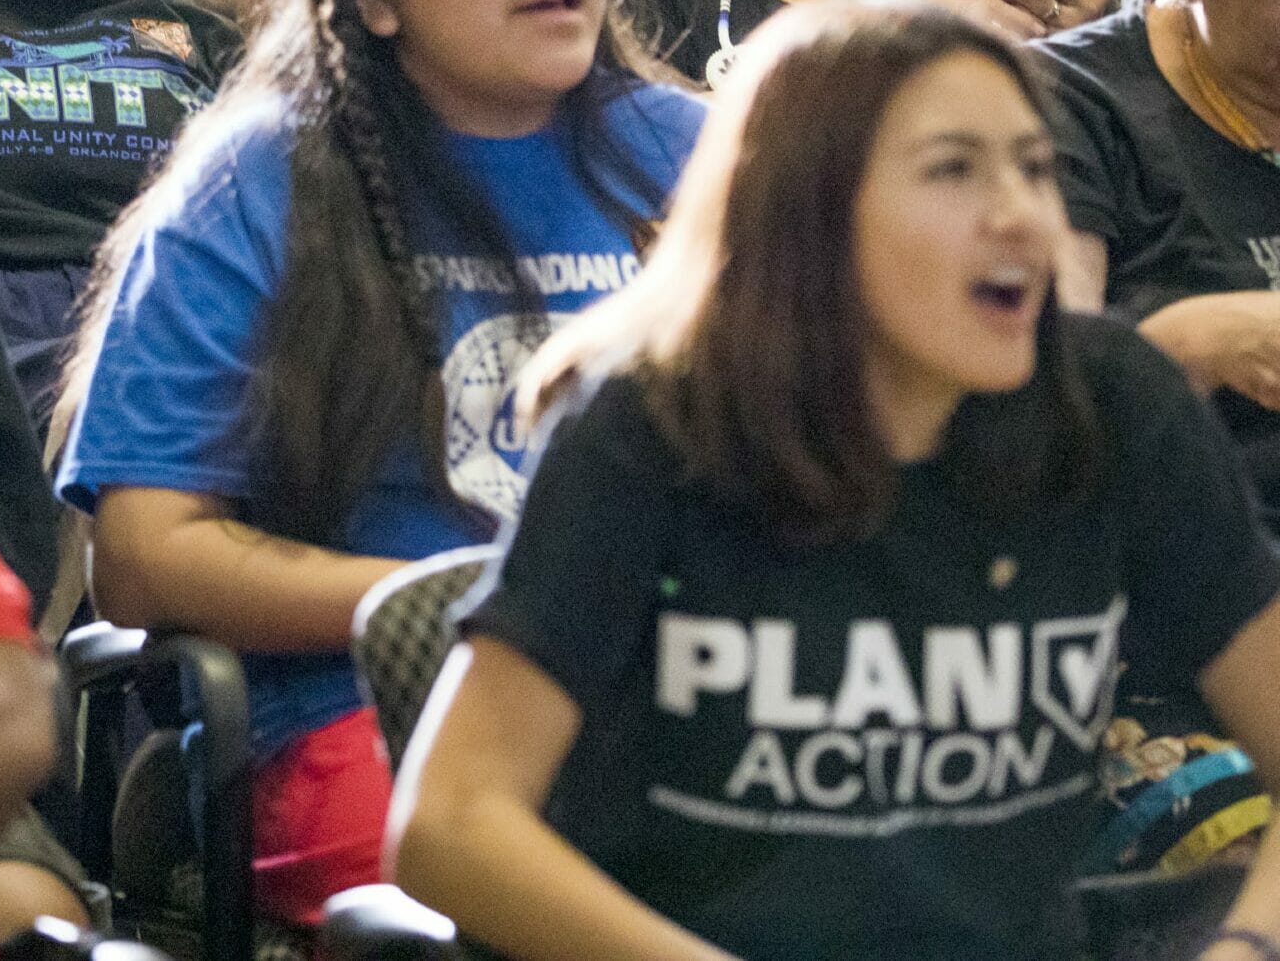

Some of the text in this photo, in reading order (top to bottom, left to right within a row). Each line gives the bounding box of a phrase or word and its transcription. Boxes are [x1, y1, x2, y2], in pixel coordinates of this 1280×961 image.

[53, 130, 116, 146] UNITY
[655, 611, 1024, 730] PLAN
[725, 728, 1056, 809] ACTION
